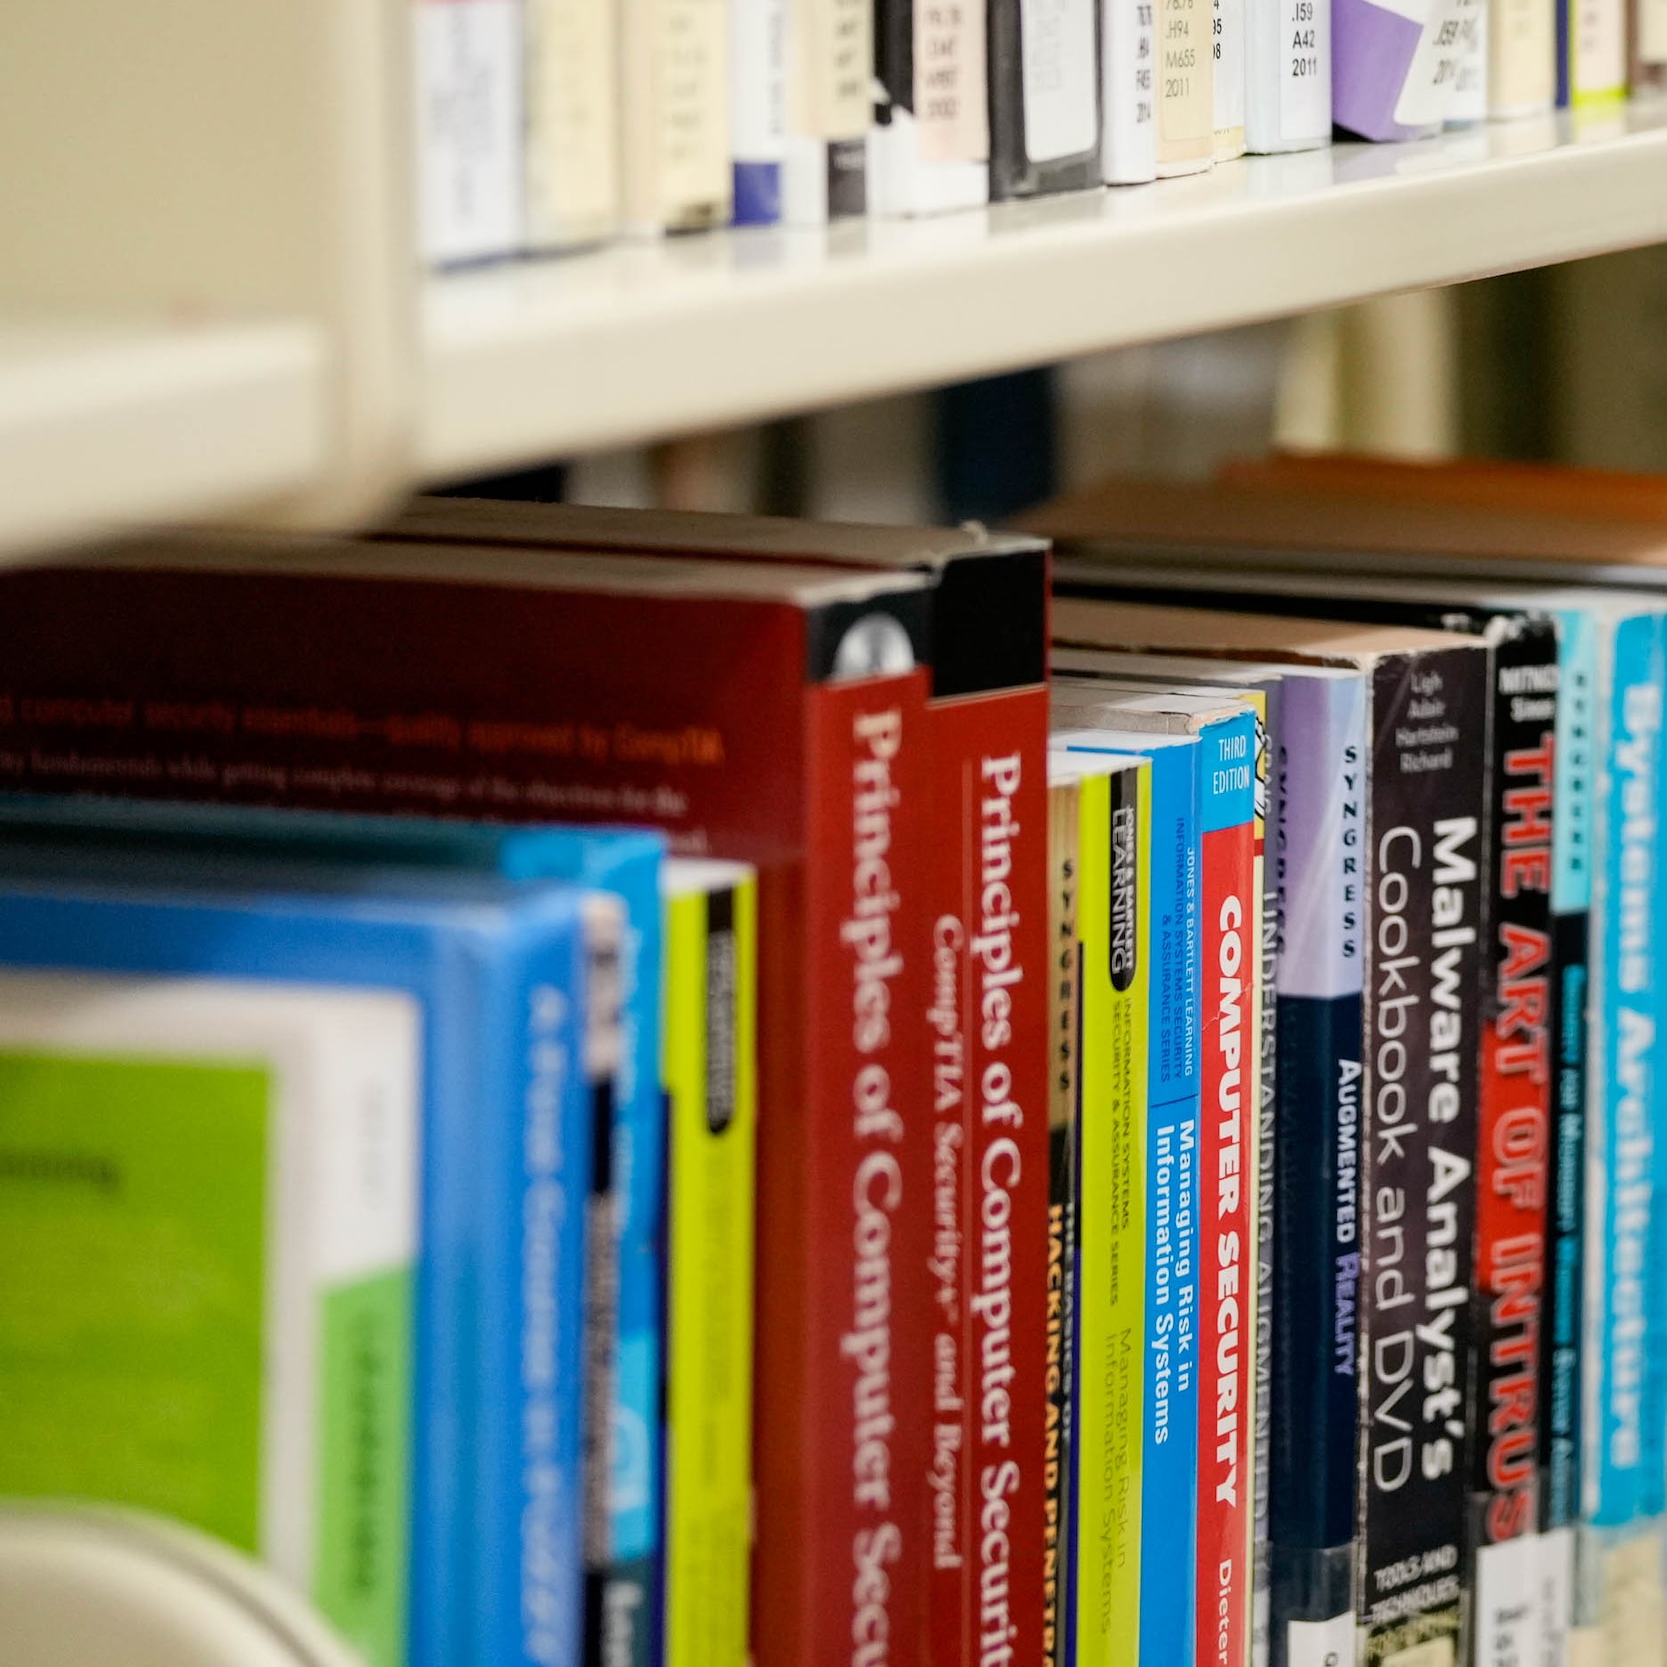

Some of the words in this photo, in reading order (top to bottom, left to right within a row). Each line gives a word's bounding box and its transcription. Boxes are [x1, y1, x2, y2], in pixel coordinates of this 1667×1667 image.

[1165, 49, 1196, 69] M655
[1165, 79, 1190, 98] 2011
[1292, 30, 1315, 50] A42
[1292, 58, 1318, 77] 2011
[1212, 766, 1250, 796] EDITION
[1218, 736, 1247, 761] THIRD
[1400, 747, 1453, 773] Richard
[1174, 818, 1185, 922] INFORMATION
[1185, 846, 1195, 898] JONES
[1342, 745, 1359, 960] SYNGRESS
[1501, 735, 1556, 899] THE
[1614, 683, 1664, 994] Systems
[841, 711, 903, 1054] Principles
[970, 749, 1024, 1051] Principles
[1110, 808, 1127, 975] LEARNING
[1162, 914, 1172, 927] &
[1185, 902, 1195, 914] &
[926, 915, 964, 1112] CompTIA
[1059, 858, 1074, 1094] SYNGRESS
[1160, 930, 1172, 1026] ASSURANCE
[1173, 929, 1185, 1003] SYSTEMS
[1184, 917, 1195, 996] BARTLETT
[1376, 824, 1422, 1160] Cookbook
[1428, 816, 1479, 1124] Malware
[1496, 922, 1551, 1085] ART
[1112, 1000, 1122, 1094] SECURITY
[1122, 997, 1133, 1136] INFORMATION
[1160, 1029, 1171, 1083] SERIES
[1173, 1008, 1184, 1080] SECURITY
[1183, 998, 1194, 1076] LEARNING
[1218, 894, 1243, 1221] COMPUTER
[1258, 891, 1278, 1245] UNDERSTANDING
[853, 1064, 905, 1144] of
[980, 1064, 1024, 1130] of
[1337, 1059, 1362, 1244] AUGMENTED
[1110, 1120, 1120, 1234] ASSURANCE
[1120, 1142, 1130, 1230] SYSTEMS
[1174, 1119, 1196, 1278] Managing
[1492, 1106, 1548, 1208] OF
[1109, 1242, 1119, 1306] SERIES
[1156, 1125, 1176, 1308] Information
[1374, 1186, 1414, 1312] and
[1609, 1004, 1656, 1470] Architecture
[840, 1150, 902, 1511] Computer
[970, 1136, 1022, 1448] Computer
[1045, 1203, 1063, 1386] HACKING
[1179, 1284, 1194, 1354] Risk
[1334, 1252, 1362, 1376] REALITY
[933, 1334, 964, 1413] and
[1102, 1335, 1117, 1501] Information
[1114, 1328, 1131, 1469] Managing
[1153, 1314, 1175, 1446] Systems
[1179, 1362, 1194, 1392] in
[1214, 1230, 1240, 1510] SECURITY
[1372, 1329, 1415, 1494] DVD
[926, 1423, 963, 1571] Beyond
[1044, 1402, 1061, 1491] AND
[1117, 1475, 1131, 1534] Risk
[1099, 1516, 1116, 1634] Systems
[1217, 1559, 1233, 1666] Dieter
